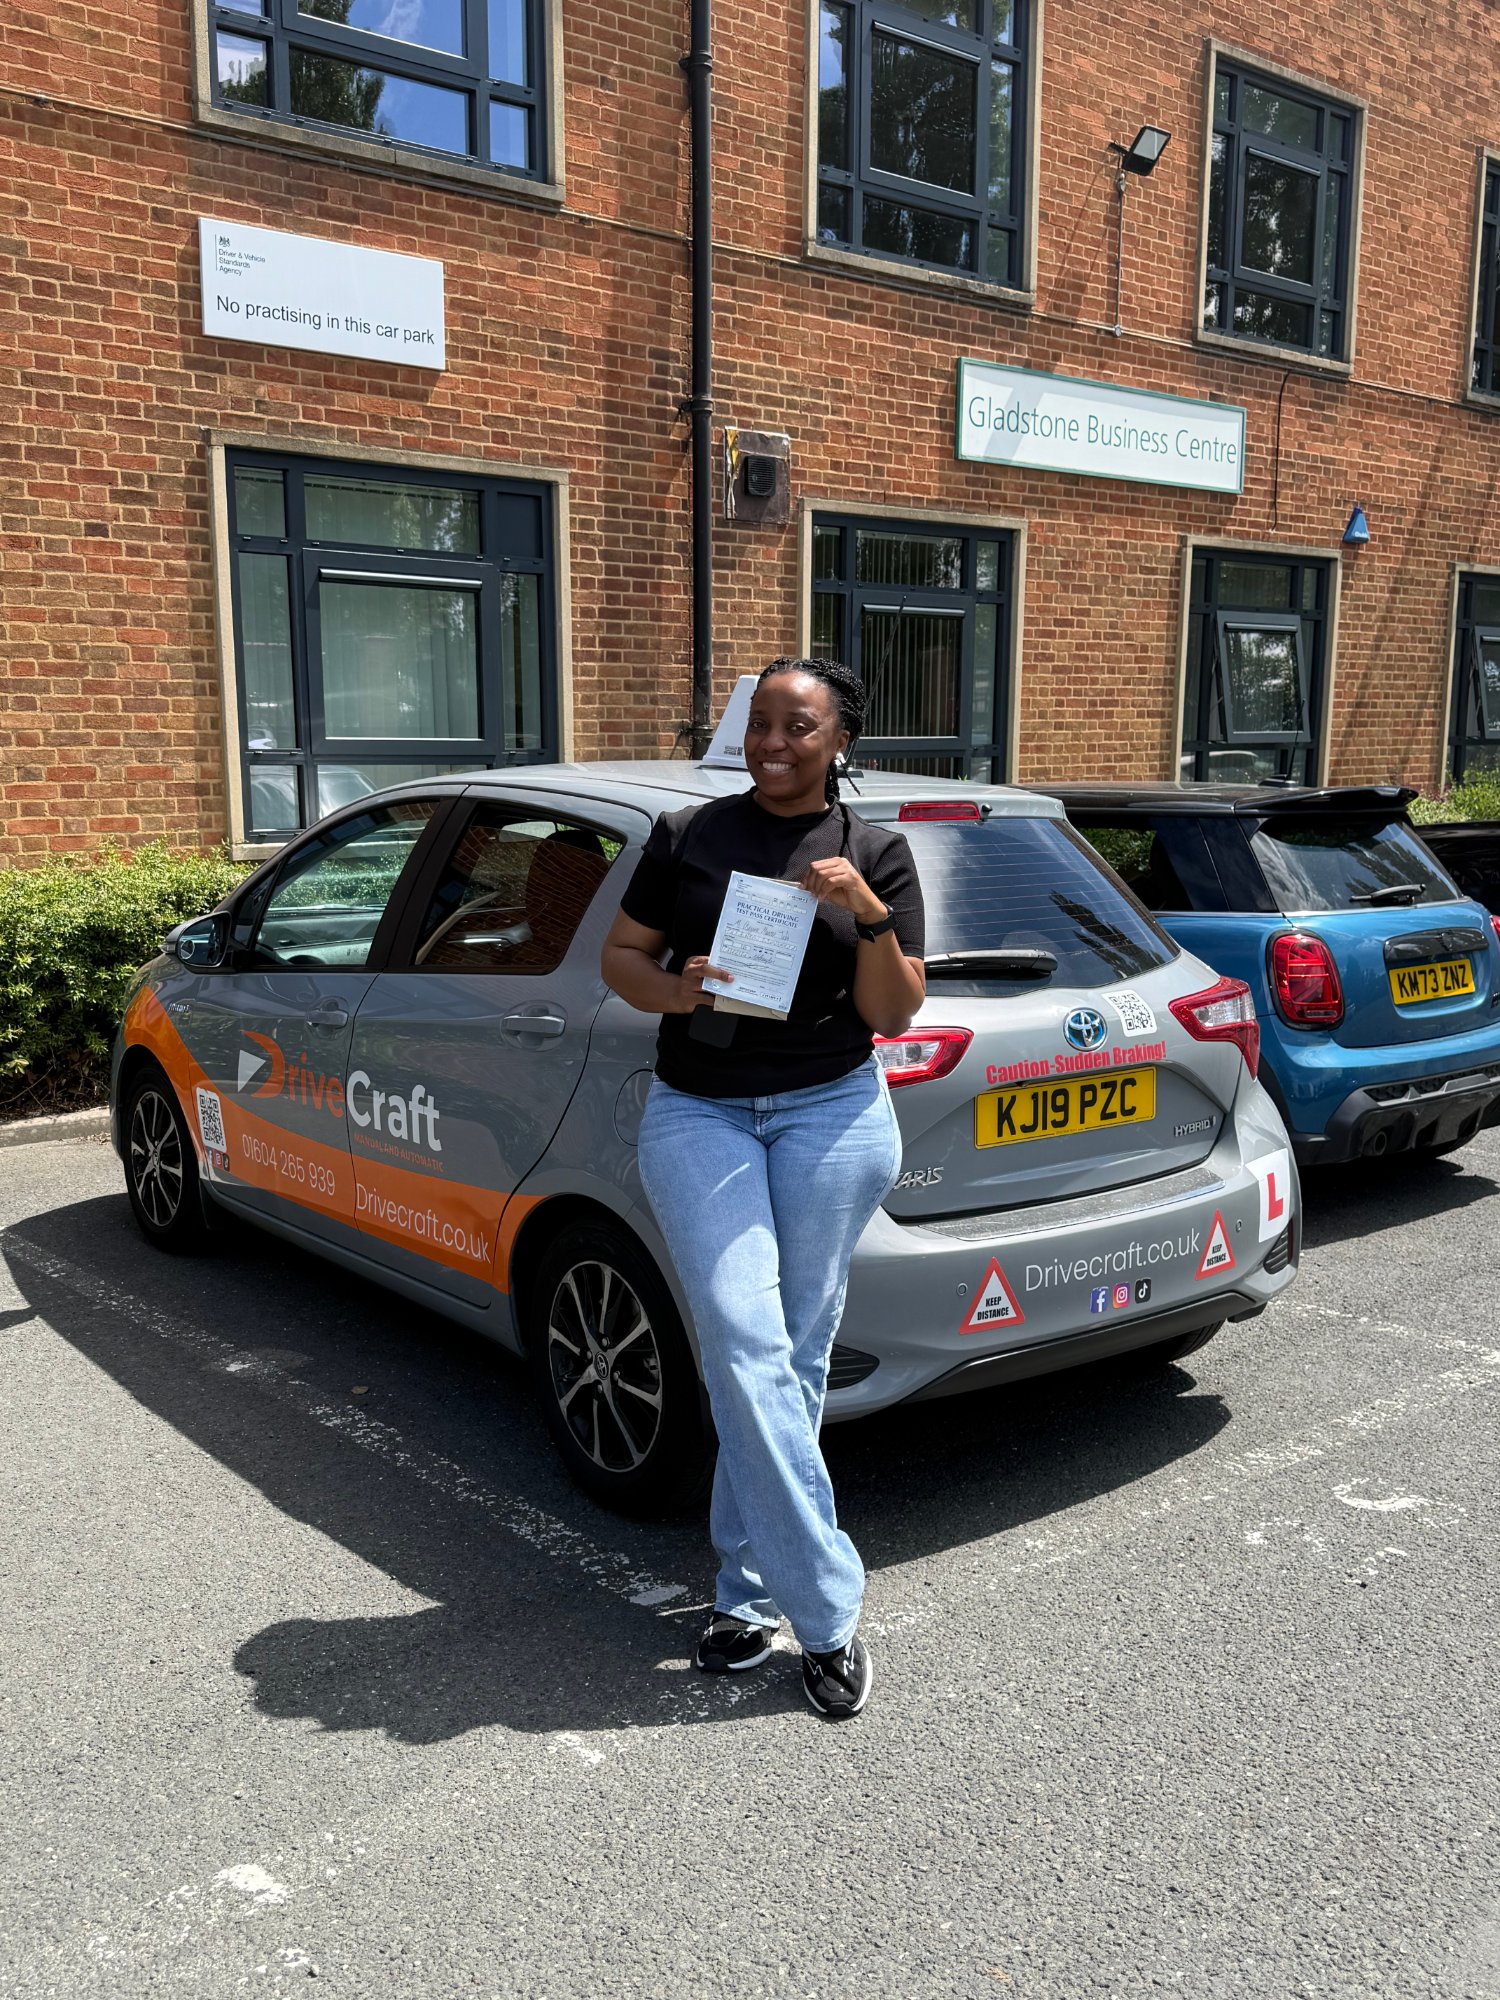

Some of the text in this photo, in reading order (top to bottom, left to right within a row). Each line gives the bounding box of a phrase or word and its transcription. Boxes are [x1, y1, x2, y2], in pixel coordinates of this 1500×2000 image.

[218, 248, 266, 263] Driver & Vehicle
[218, 256, 251, 269] Standards
[218, 264, 242, 277] Agency
[217, 295, 435, 345] No practising in this car park
[968, 396, 1237, 464] Gladstone Business Centre
[736, 907, 749, 916] TEST
[749, 911, 763, 919] PASS
[763, 915, 799, 929] CERTIFICATE
[737, 901, 770, 917] PRACTICAL
[771, 910, 799, 923] DRIVING
[1397, 964, 1469, 998] KM73 ZNZ
[1112, 1040, 1167, 1065] Braking!
[997, 1077, 1137, 1138] KJ19 PZC
[1174, 1118, 1210, 1137] HYBRID
[242, 1134, 278, 1172] 01604
[280, 1150, 305, 1183] 265
[308, 1162, 335, 1196] 939
[400, 1149, 444, 1173] AUTOMATIC
[1266, 1172, 1284, 1221] L
[356, 1183, 491, 1264] Drivecraft.co.uk
[1025, 1228, 1200, 1292] Drivecraft.co.uk
[1206, 1253, 1227, 1267] DISTANCE
[985, 1296, 1002, 1307] KEEP
[977, 1307, 1009, 1321] DISTANCE
